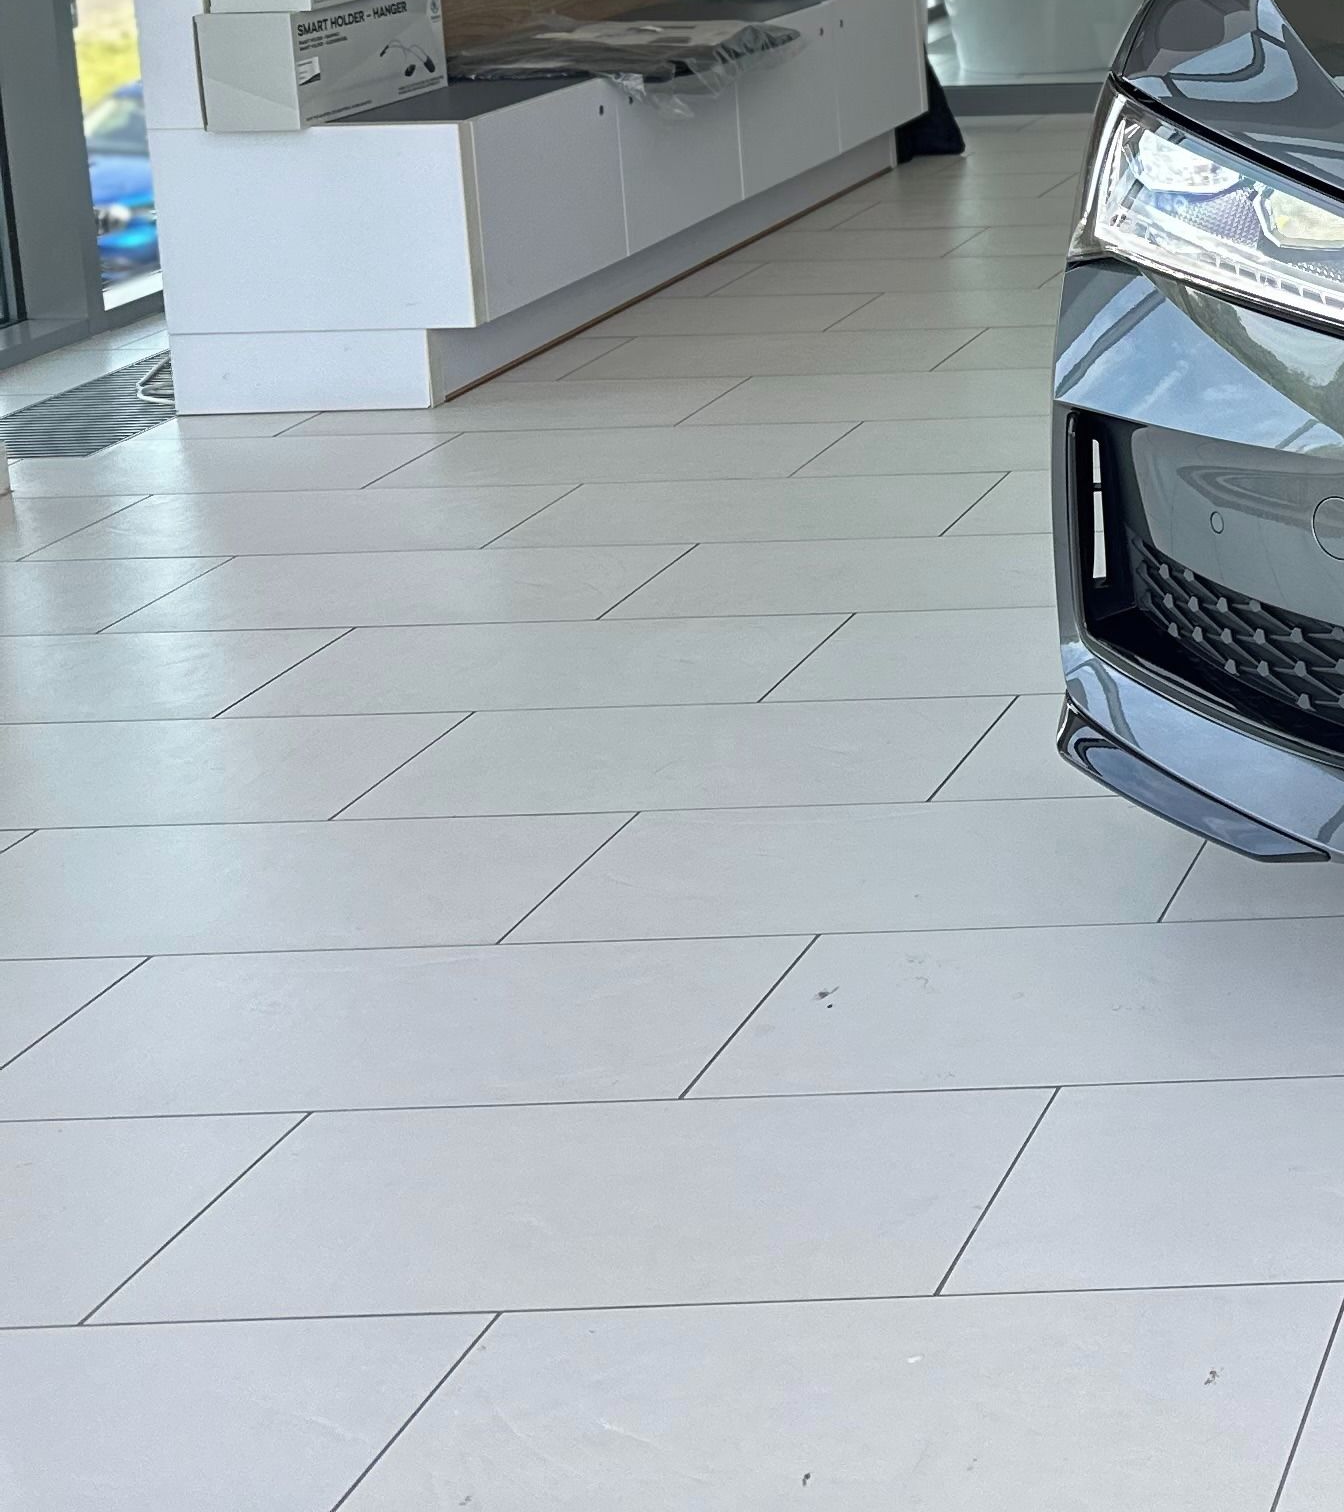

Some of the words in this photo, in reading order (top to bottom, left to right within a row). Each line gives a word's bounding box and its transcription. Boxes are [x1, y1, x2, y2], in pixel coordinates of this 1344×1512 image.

[297, 18, 329, 37] SMART
[330, 10, 366, 29] HOLDER
[372, 1, 408, 19] HANGER
